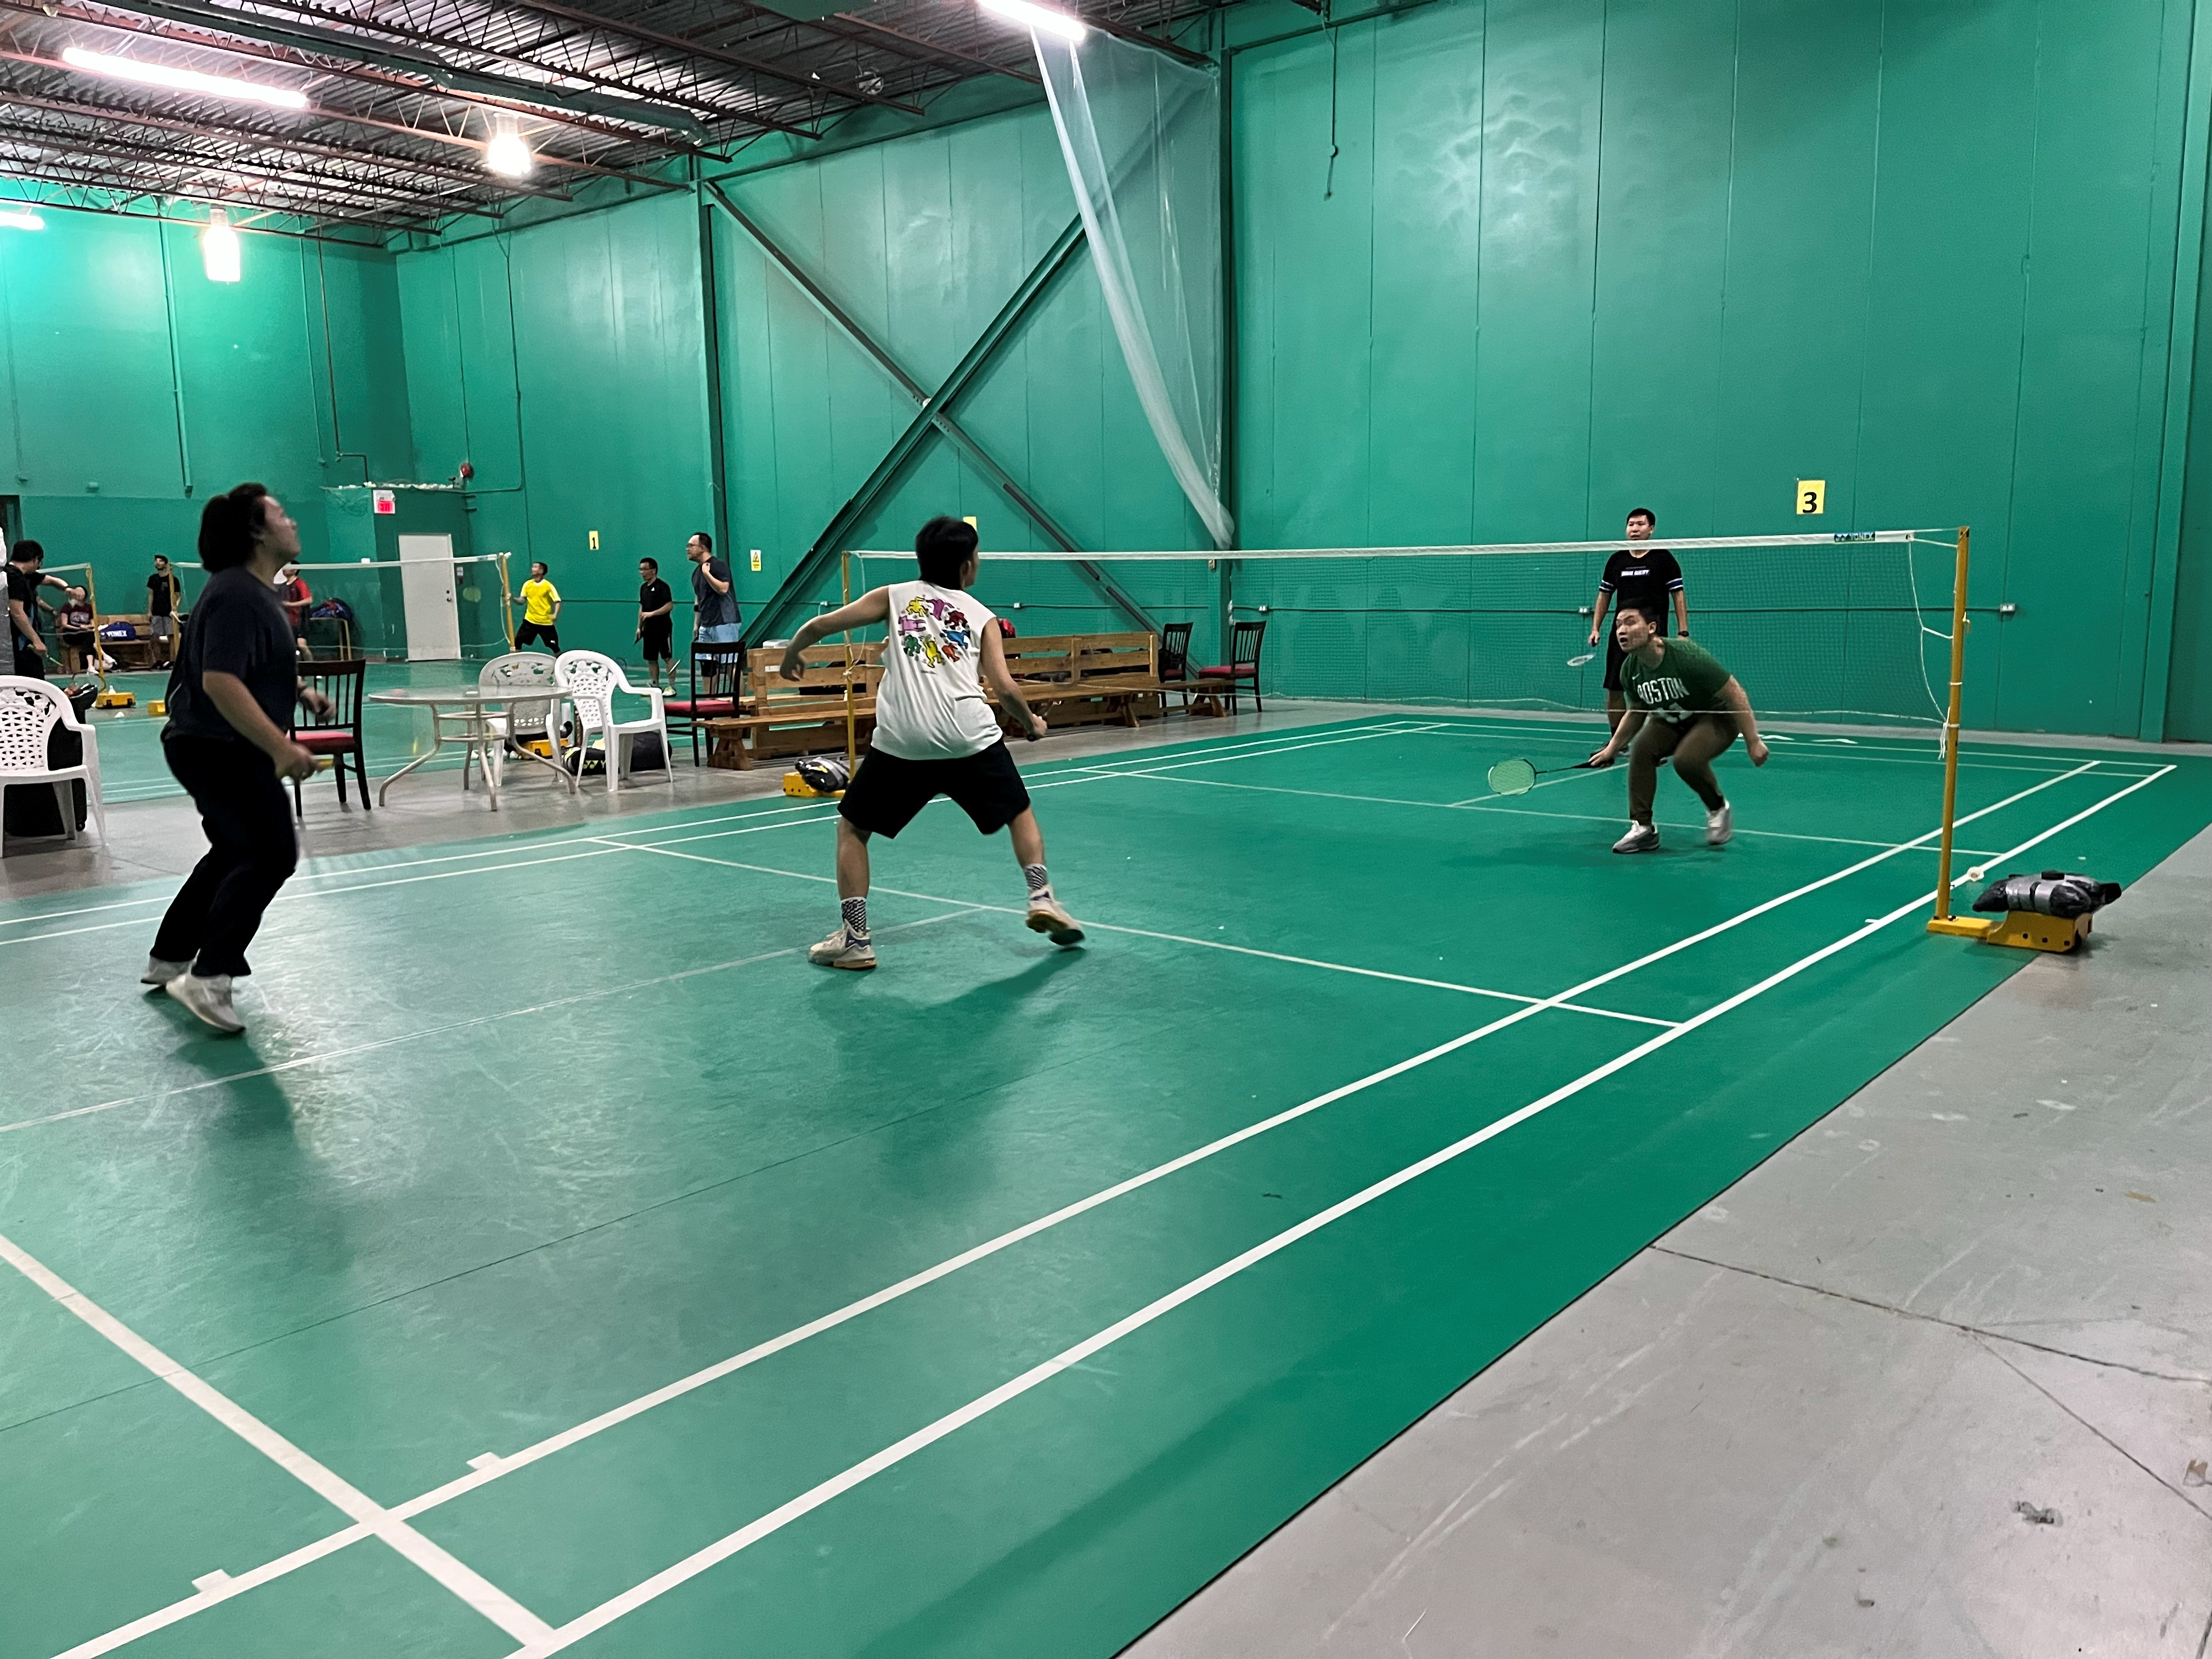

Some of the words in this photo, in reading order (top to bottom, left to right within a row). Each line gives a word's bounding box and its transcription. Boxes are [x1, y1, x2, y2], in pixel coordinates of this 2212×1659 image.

[1803, 492, 1817, 513] 3
[592, 537, 596, 549] 1
[1637, 678, 1690, 704] BOSTON
